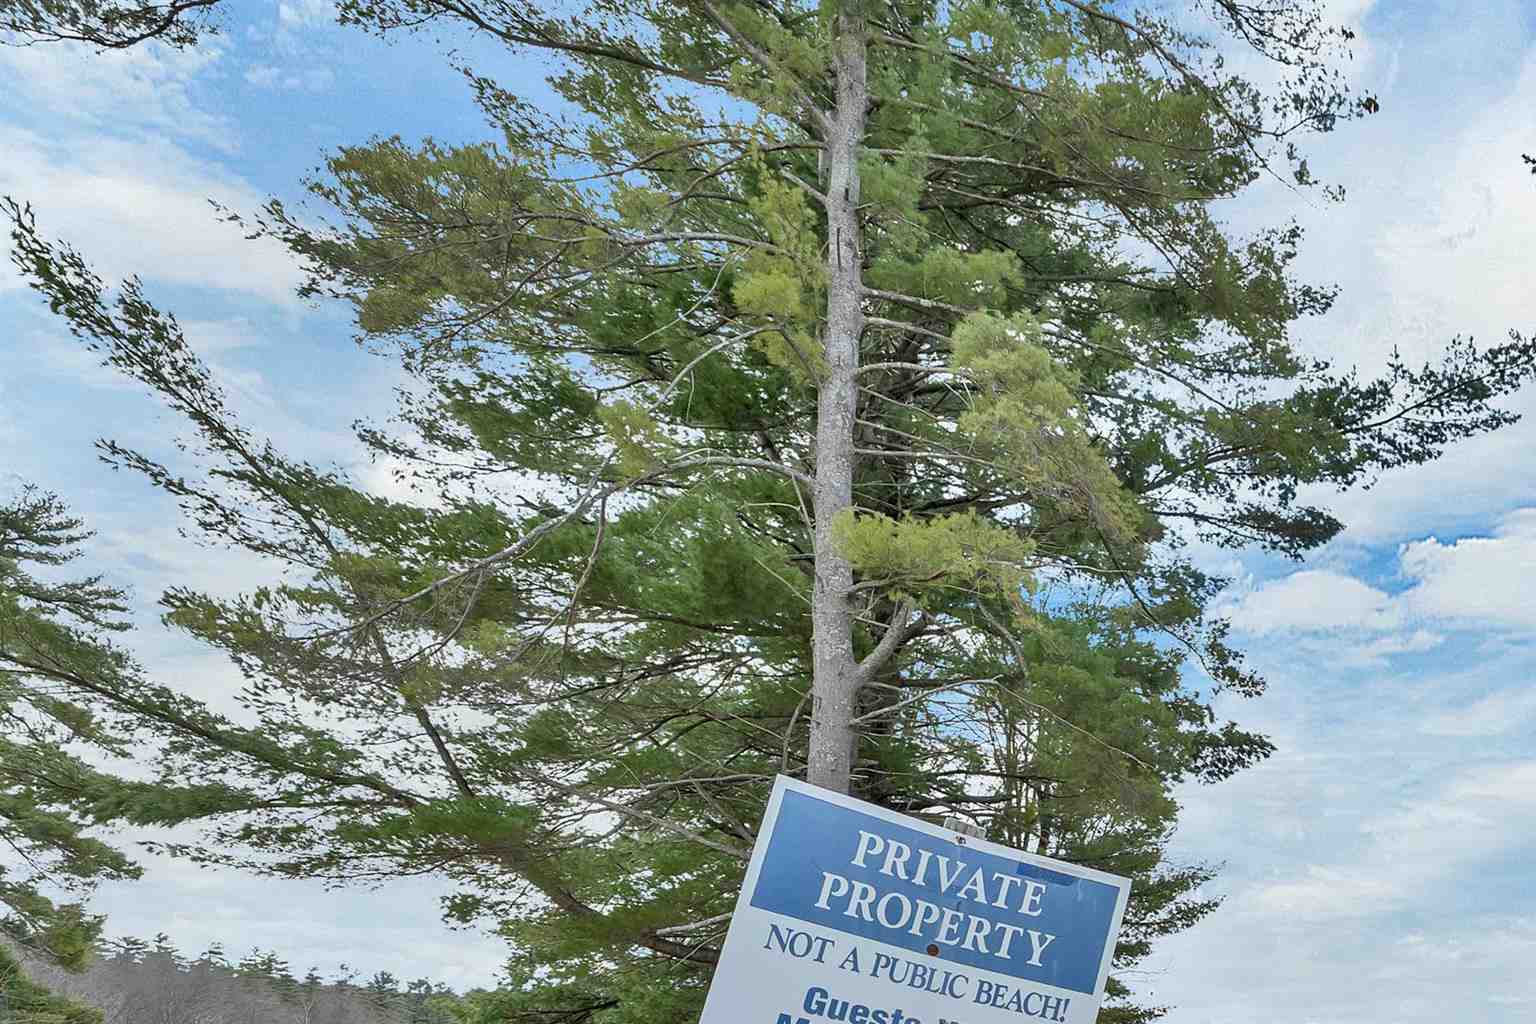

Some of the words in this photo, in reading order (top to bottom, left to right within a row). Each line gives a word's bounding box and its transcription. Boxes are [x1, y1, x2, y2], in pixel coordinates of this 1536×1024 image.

[815, 871, 1055, 967] PROPERTY
[851, 830, 1047, 917] PRIVATE
[763, 924, 835, 963] NOT
[840, 946, 861, 973] A
[870, 951, 970, 999] PUBLIC
[973, 978, 1070, 1023] BEACH!
